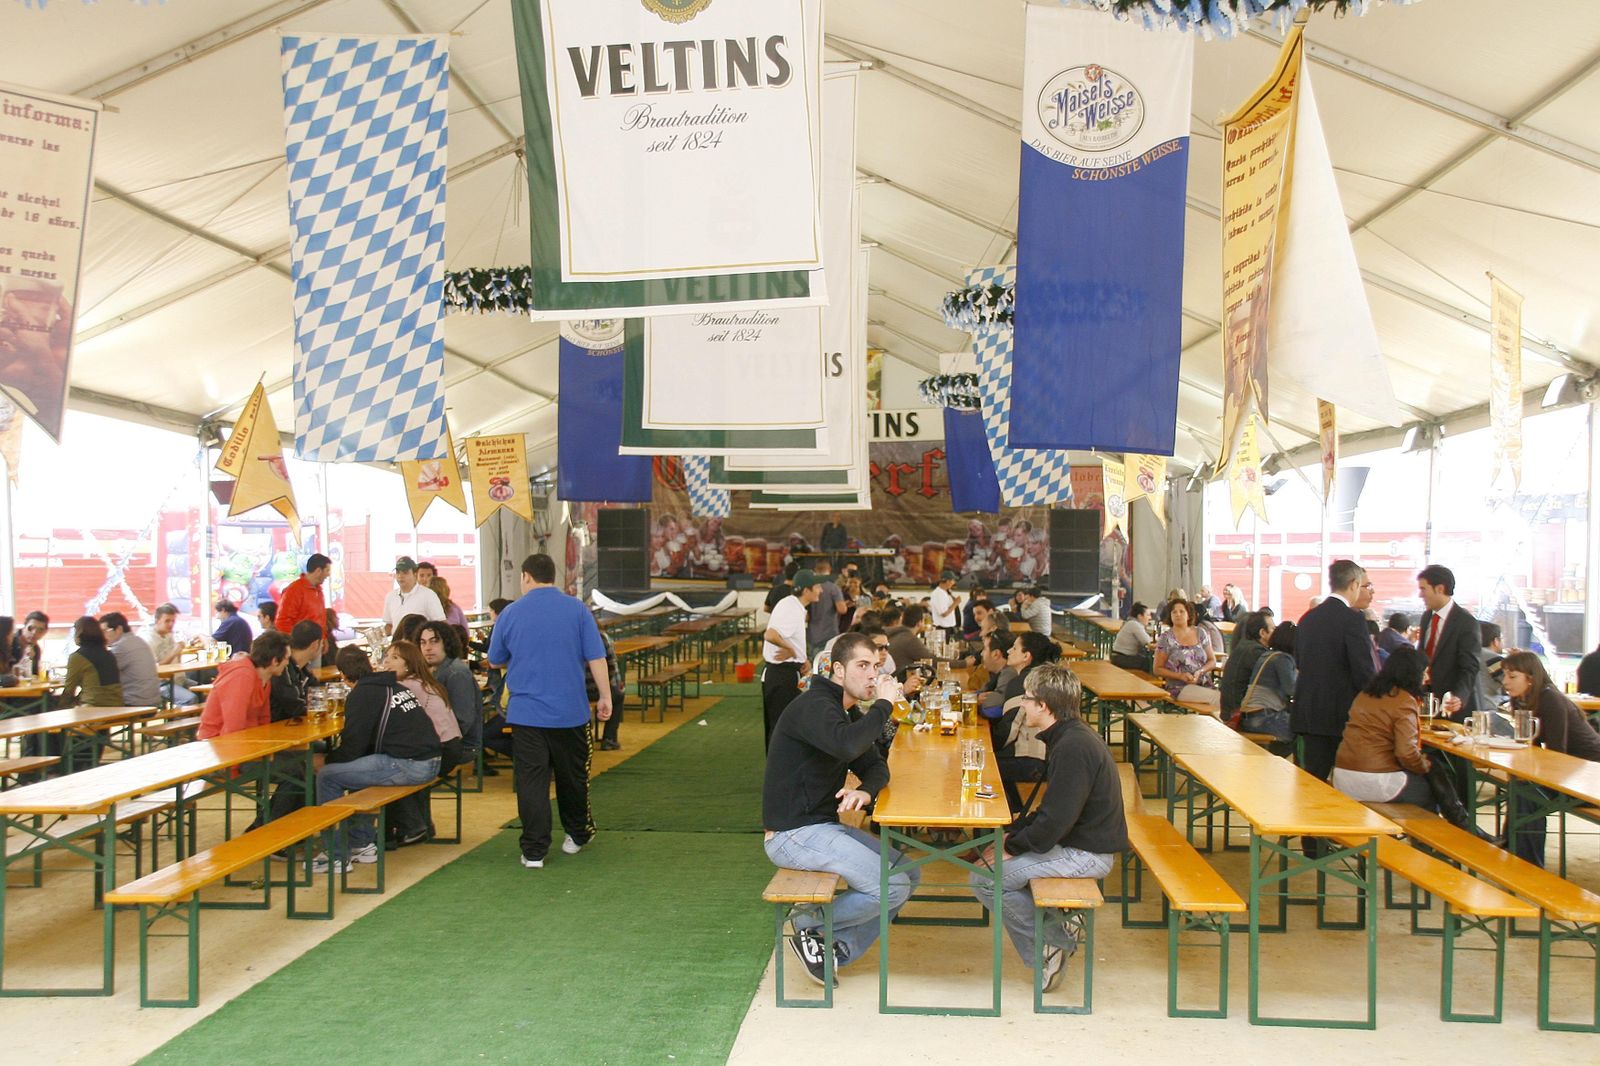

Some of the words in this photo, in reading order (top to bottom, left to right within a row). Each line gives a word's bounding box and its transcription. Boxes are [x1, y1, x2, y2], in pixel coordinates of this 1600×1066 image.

[567, 35, 793, 97] VELTINS
[3, 99, 90, 131] informa:
[620, 102, 750, 131] Brautradition
[1049, 75, 1113, 129] Maisel's
[1078, 91, 1134, 129] Weisse
[646, 132, 677, 153] seit
[682, 130, 723, 151] 1824
[1031, 138, 1051, 155] DAS
[1052, 150, 1077, 165] BIER
[1078, 157, 1101, 168] AUF
[1102, 150, 1133, 167] SEINE
[1072, 160, 1140, 181] SCHÖNSTE
[1141, 140, 1183, 166] WEISSE.
[692, 310, 779, 327] Brautradition
[707, 331, 727, 343] seit
[732, 329, 761, 342] 1824
